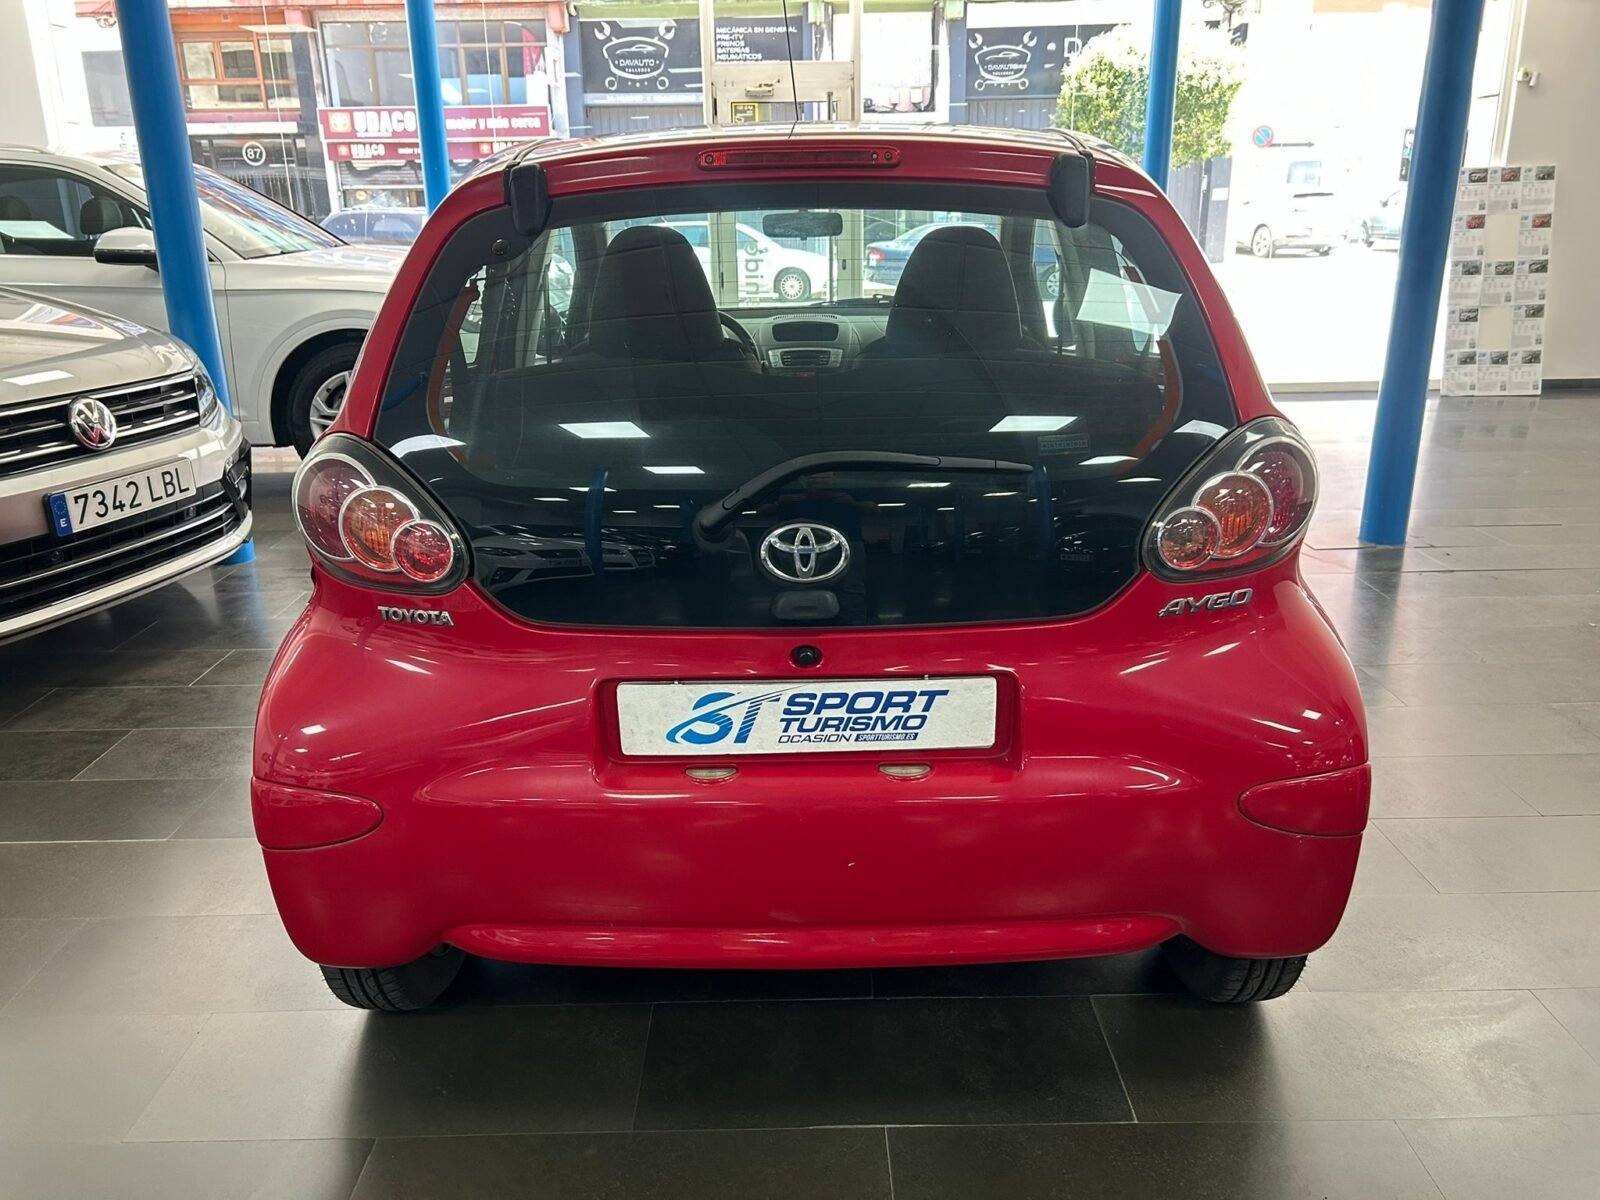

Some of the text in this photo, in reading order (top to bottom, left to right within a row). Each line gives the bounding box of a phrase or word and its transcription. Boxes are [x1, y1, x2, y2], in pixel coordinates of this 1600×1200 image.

[716, 25, 753, 34] MECÁNICA
[753, 26, 765, 34] EN
[619, 59, 655, 67] DAVAUTO
[716, 53, 762, 61] NEUMÁTICOS
[353, 110, 416, 132] UDACO
[246, 147, 261, 159] 87
[350, 143, 385, 156] UDACO
[73, 467, 190, 525] 7342 LBL
[59, 518, 68, 528] E
[1157, 587, 1254, 618] AYGO
[377, 605, 455, 627] TOYOTA
[782, 689, 950, 716] SPORT
[779, 713, 928, 734] TURISMO
[777, 732, 916, 745] OCASION SPORTTURISMO.ES
